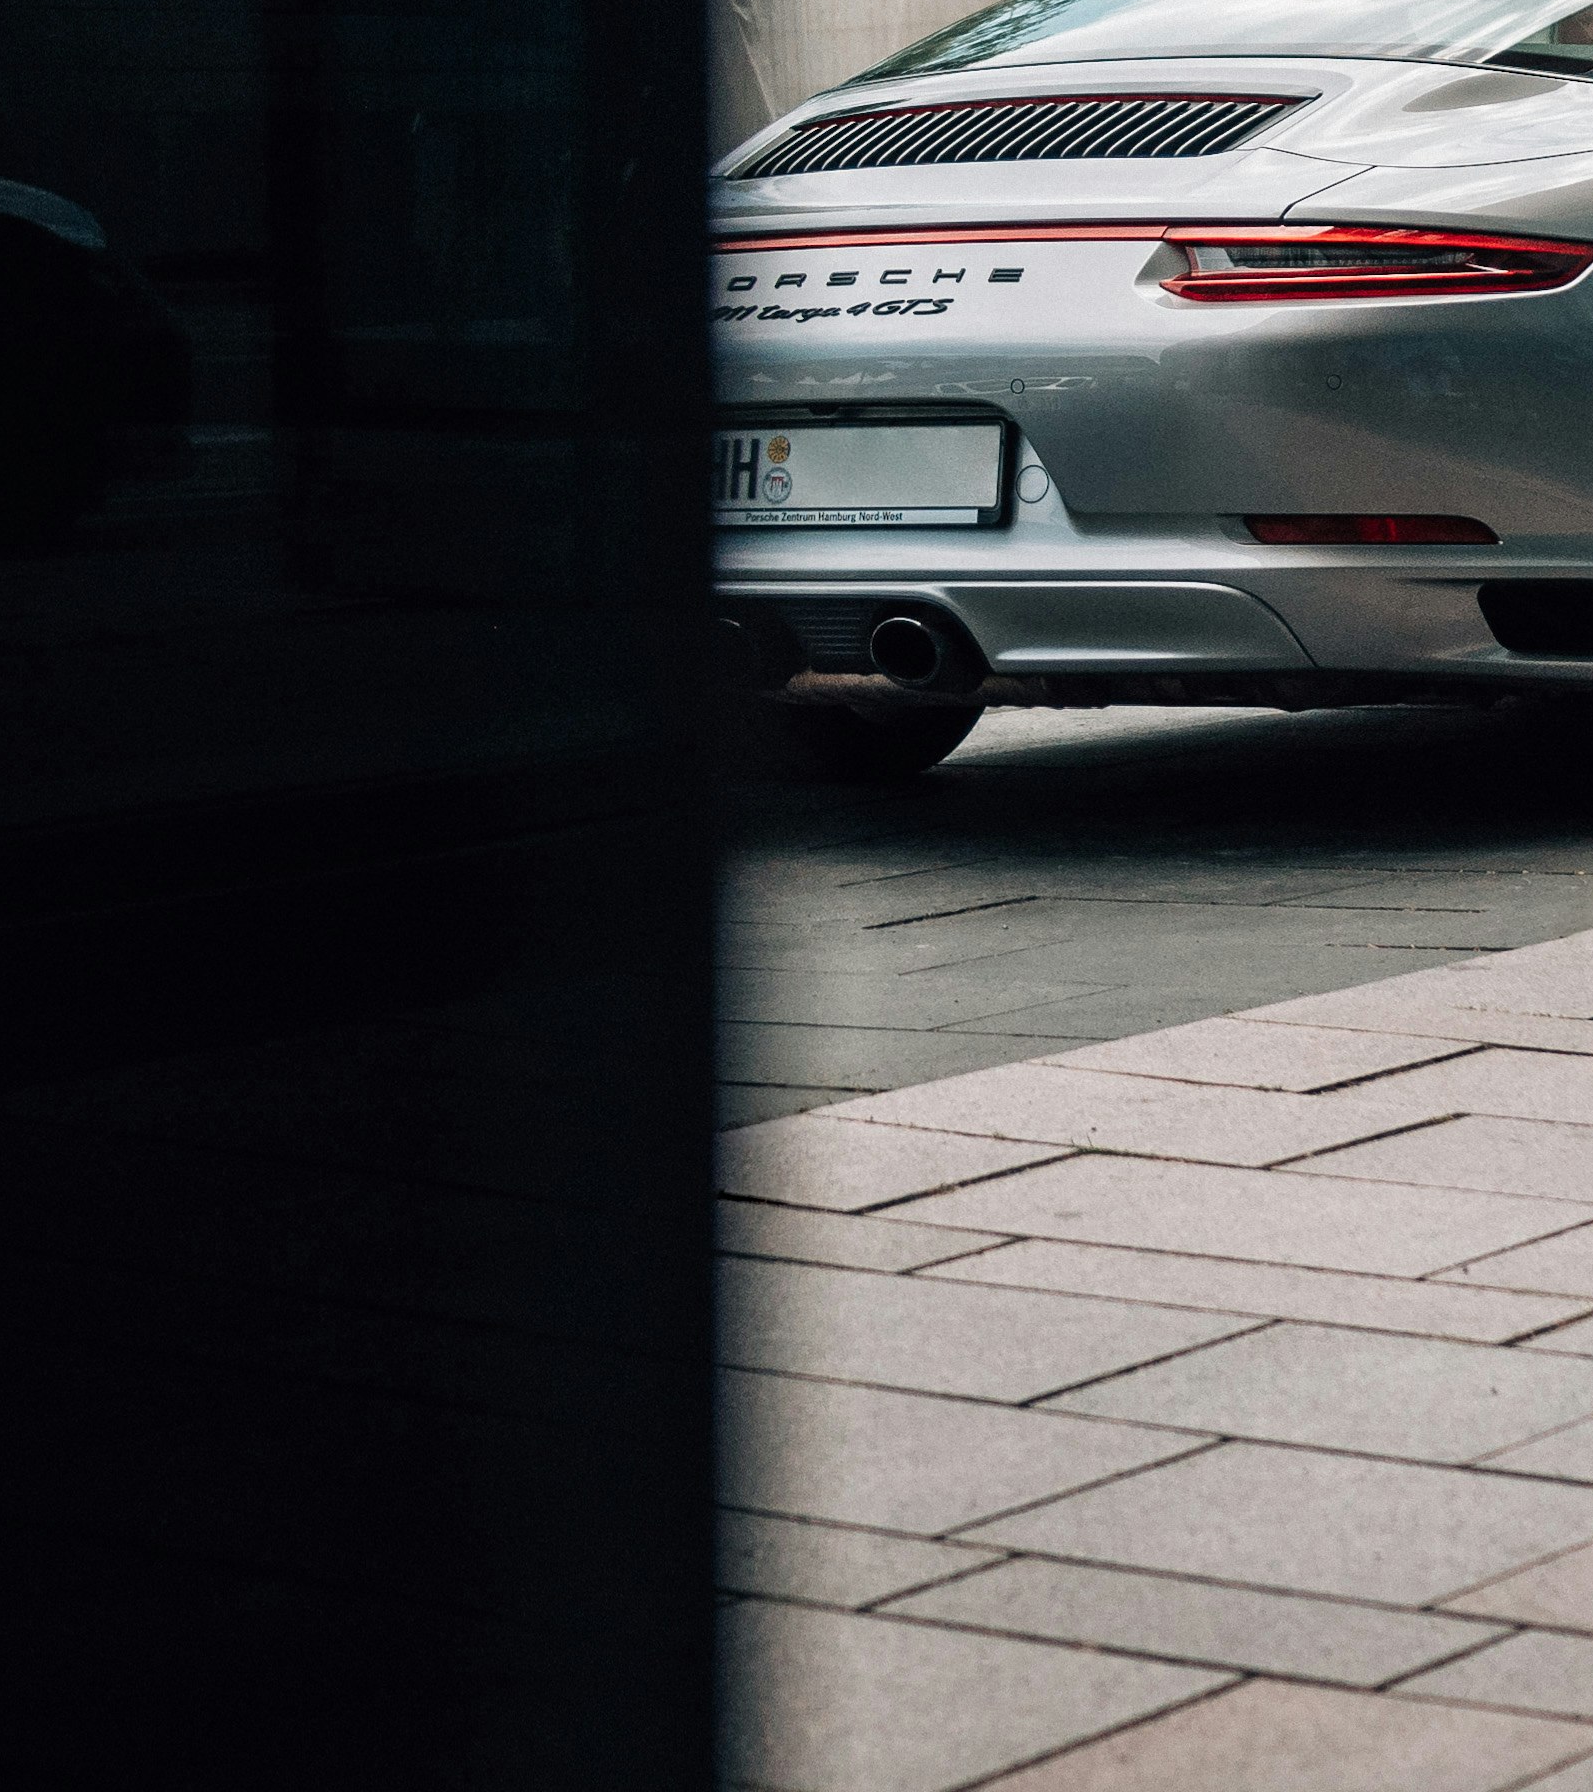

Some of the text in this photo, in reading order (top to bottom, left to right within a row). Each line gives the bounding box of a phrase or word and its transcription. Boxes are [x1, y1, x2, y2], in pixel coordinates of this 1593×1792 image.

[846, 301, 872, 317] 4
[872, 298, 955, 316] GTS
[745, 511, 903, 523] Porsche Zentrum Hamburg Nord-West
